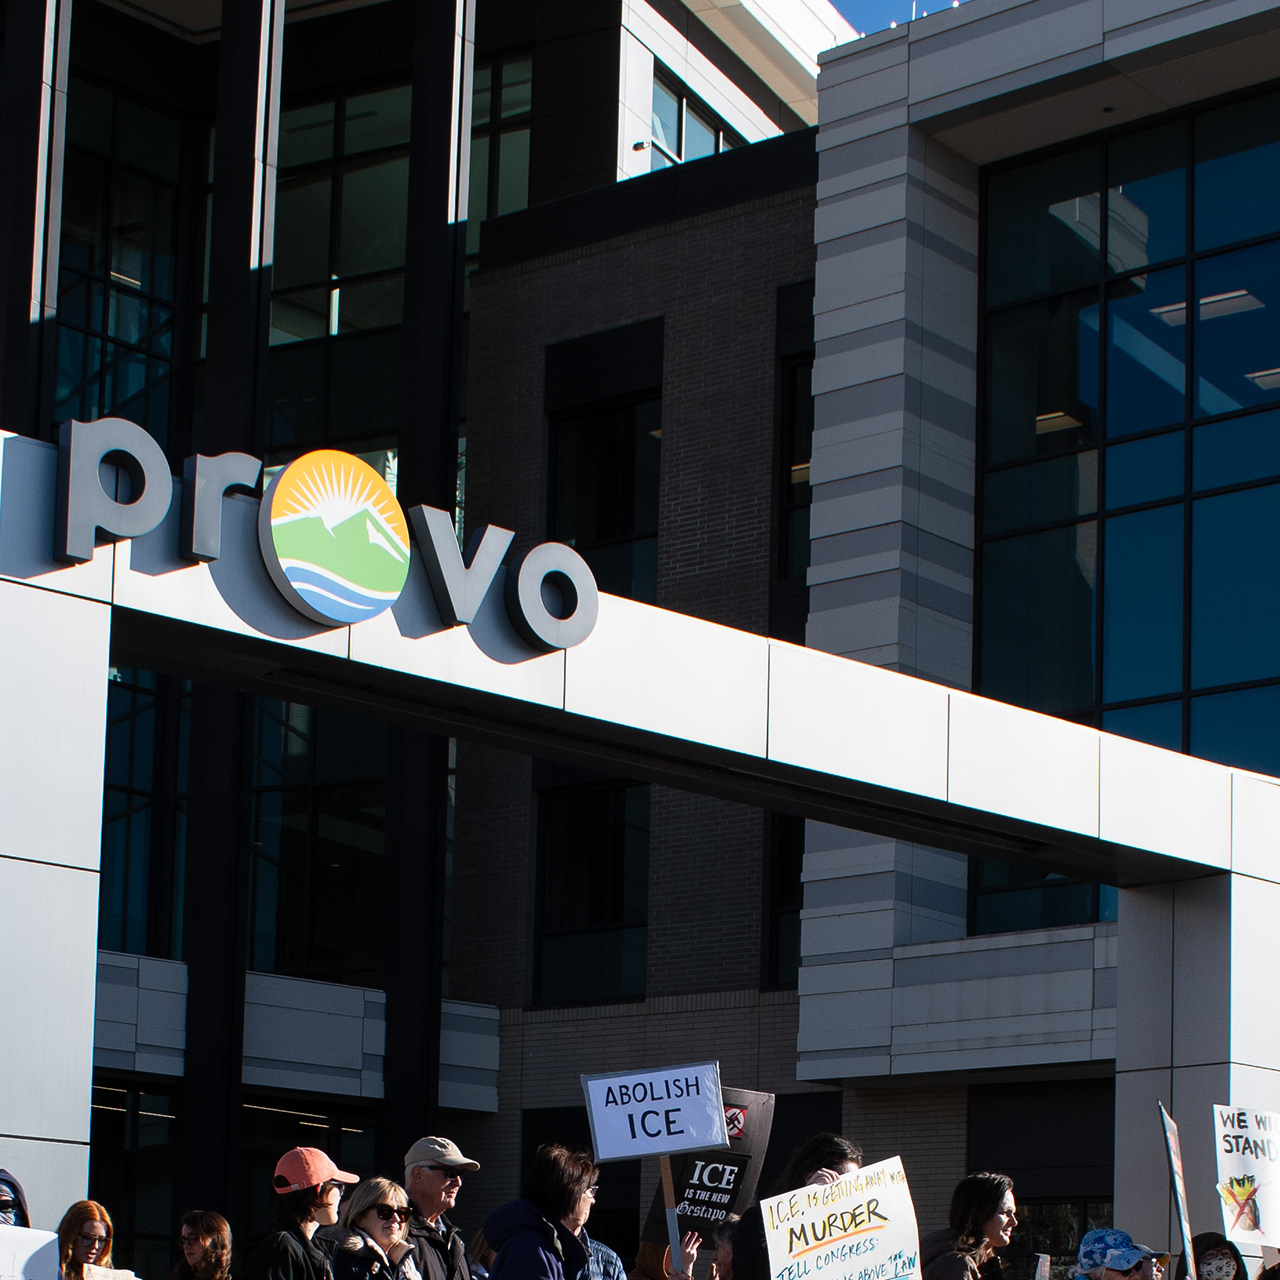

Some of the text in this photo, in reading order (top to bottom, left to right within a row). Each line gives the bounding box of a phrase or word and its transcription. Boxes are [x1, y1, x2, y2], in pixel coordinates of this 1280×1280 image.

[605, 1076, 701, 1107] ABOLISH
[627, 1108, 685, 1140] ICE
[1219, 1110, 1249, 1130] WE
[689, 1160, 739, 1189] ICE
[684, 1188, 731, 1204] IS THE NEW
[807, 1191, 819, 1209] IS
[676, 1200, 727, 1221] Gestapo
[788, 1198, 890, 1254] MURDER
[894, 1250, 917, 1278] LAW
